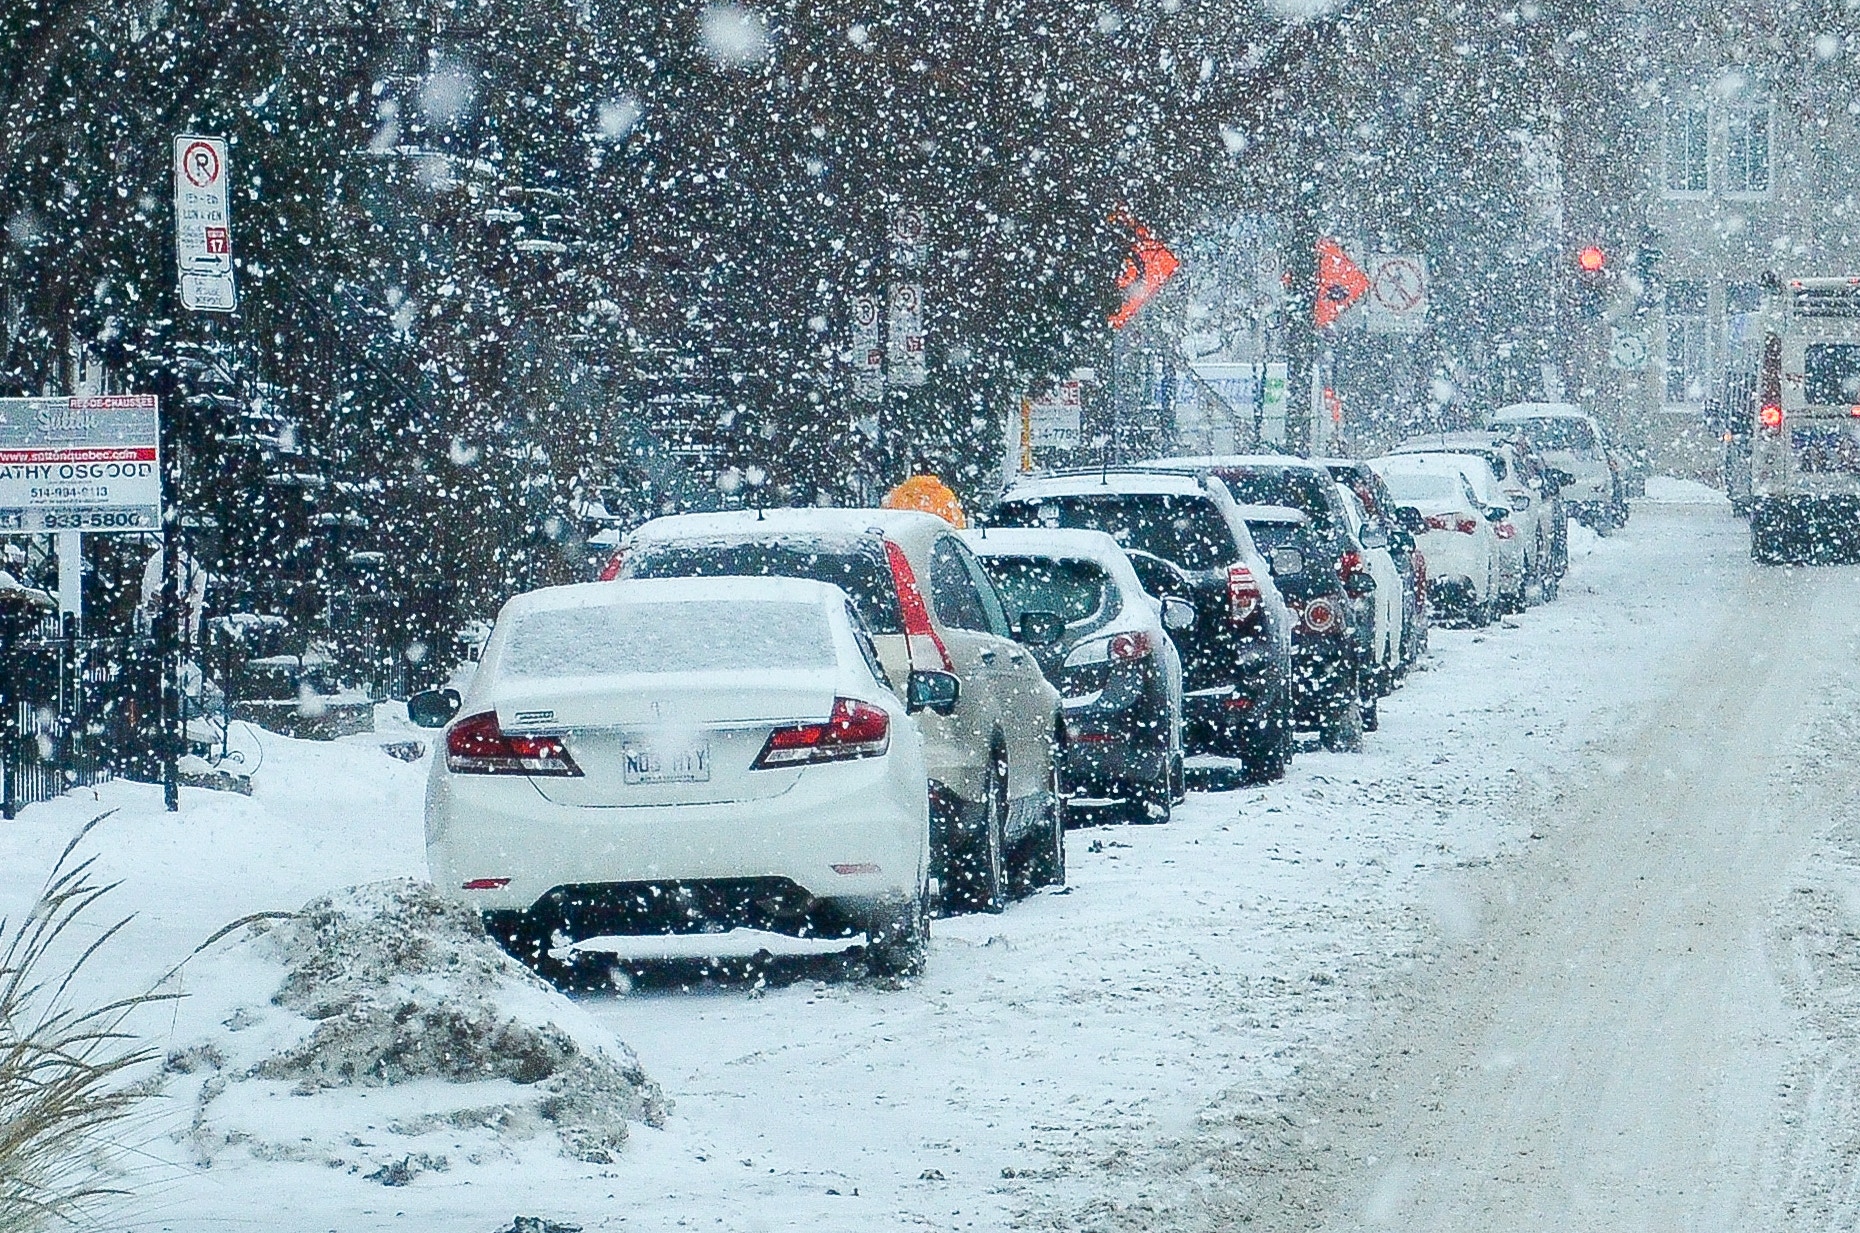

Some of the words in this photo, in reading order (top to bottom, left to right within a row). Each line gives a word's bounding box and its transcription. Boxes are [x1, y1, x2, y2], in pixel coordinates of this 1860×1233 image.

[209, 239, 224, 253] 17
[0, 449, 137, 463] www.suttonquebec.com
[59, 463, 152, 479] OSGOOD
